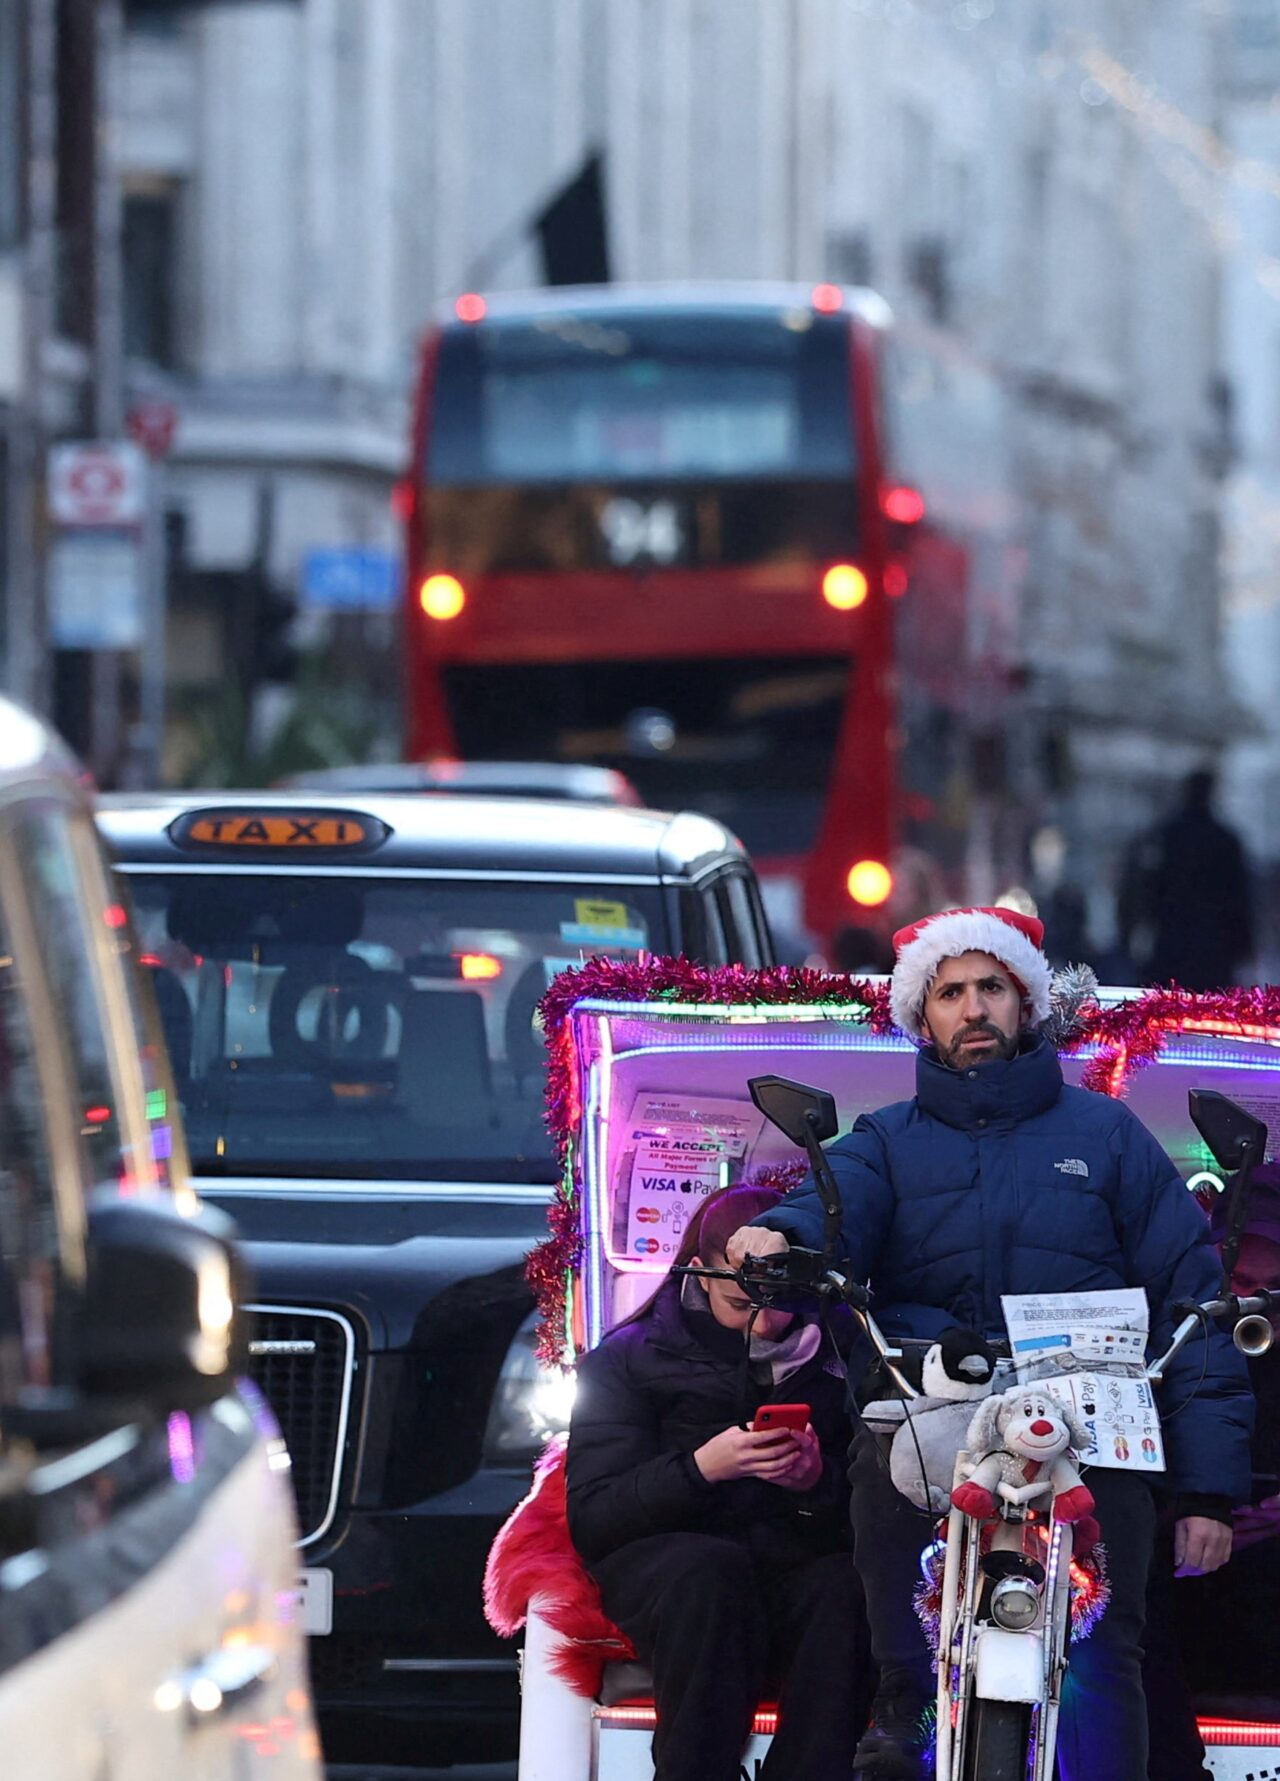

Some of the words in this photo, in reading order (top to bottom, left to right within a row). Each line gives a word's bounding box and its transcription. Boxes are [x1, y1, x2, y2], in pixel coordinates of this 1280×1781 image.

[207, 820, 346, 842] TAXI
[649, 1140, 669, 1149] WE
[672, 1141, 724, 1152] ACCEPT
[661, 1154, 682, 1162] Major
[664, 1162, 697, 1170] Payment
[641, 1177, 676, 1191] VISA
[694, 1180, 718, 1195] Pay
[1082, 1381, 1097, 1401] Pay
[1136, 1384, 1146, 1404] VISA
